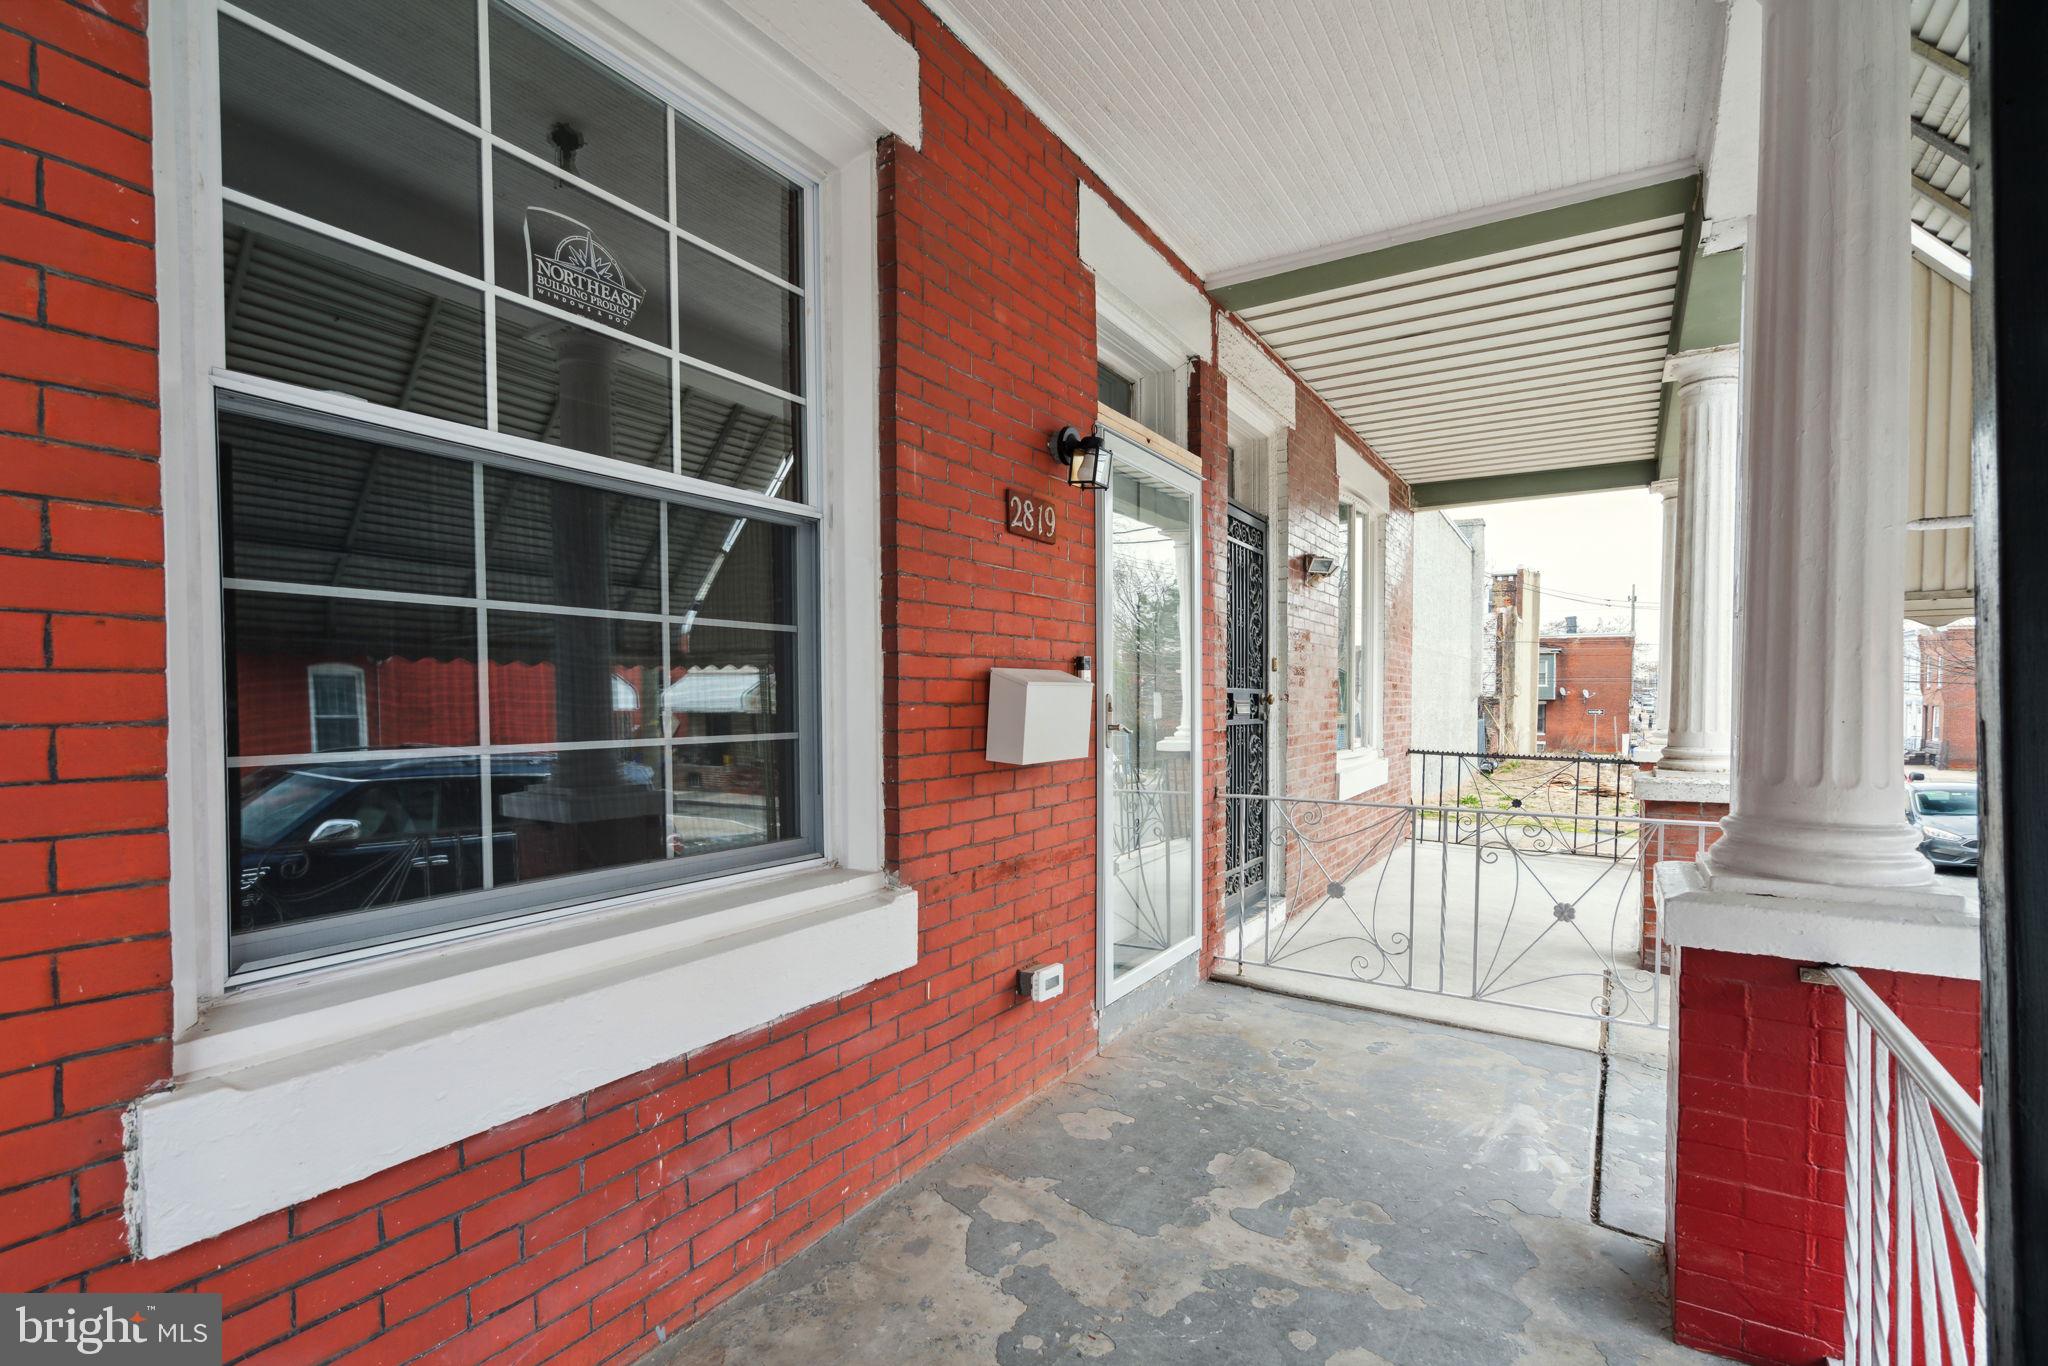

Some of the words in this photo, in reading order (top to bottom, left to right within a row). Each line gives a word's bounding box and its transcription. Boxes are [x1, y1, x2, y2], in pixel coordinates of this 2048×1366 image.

[536, 258, 641, 311] NORTHEAST
[537, 275, 588, 301] BUILDING
[537, 287, 591, 312] WINDOWS
[1011, 496, 1056, 537] 2819
